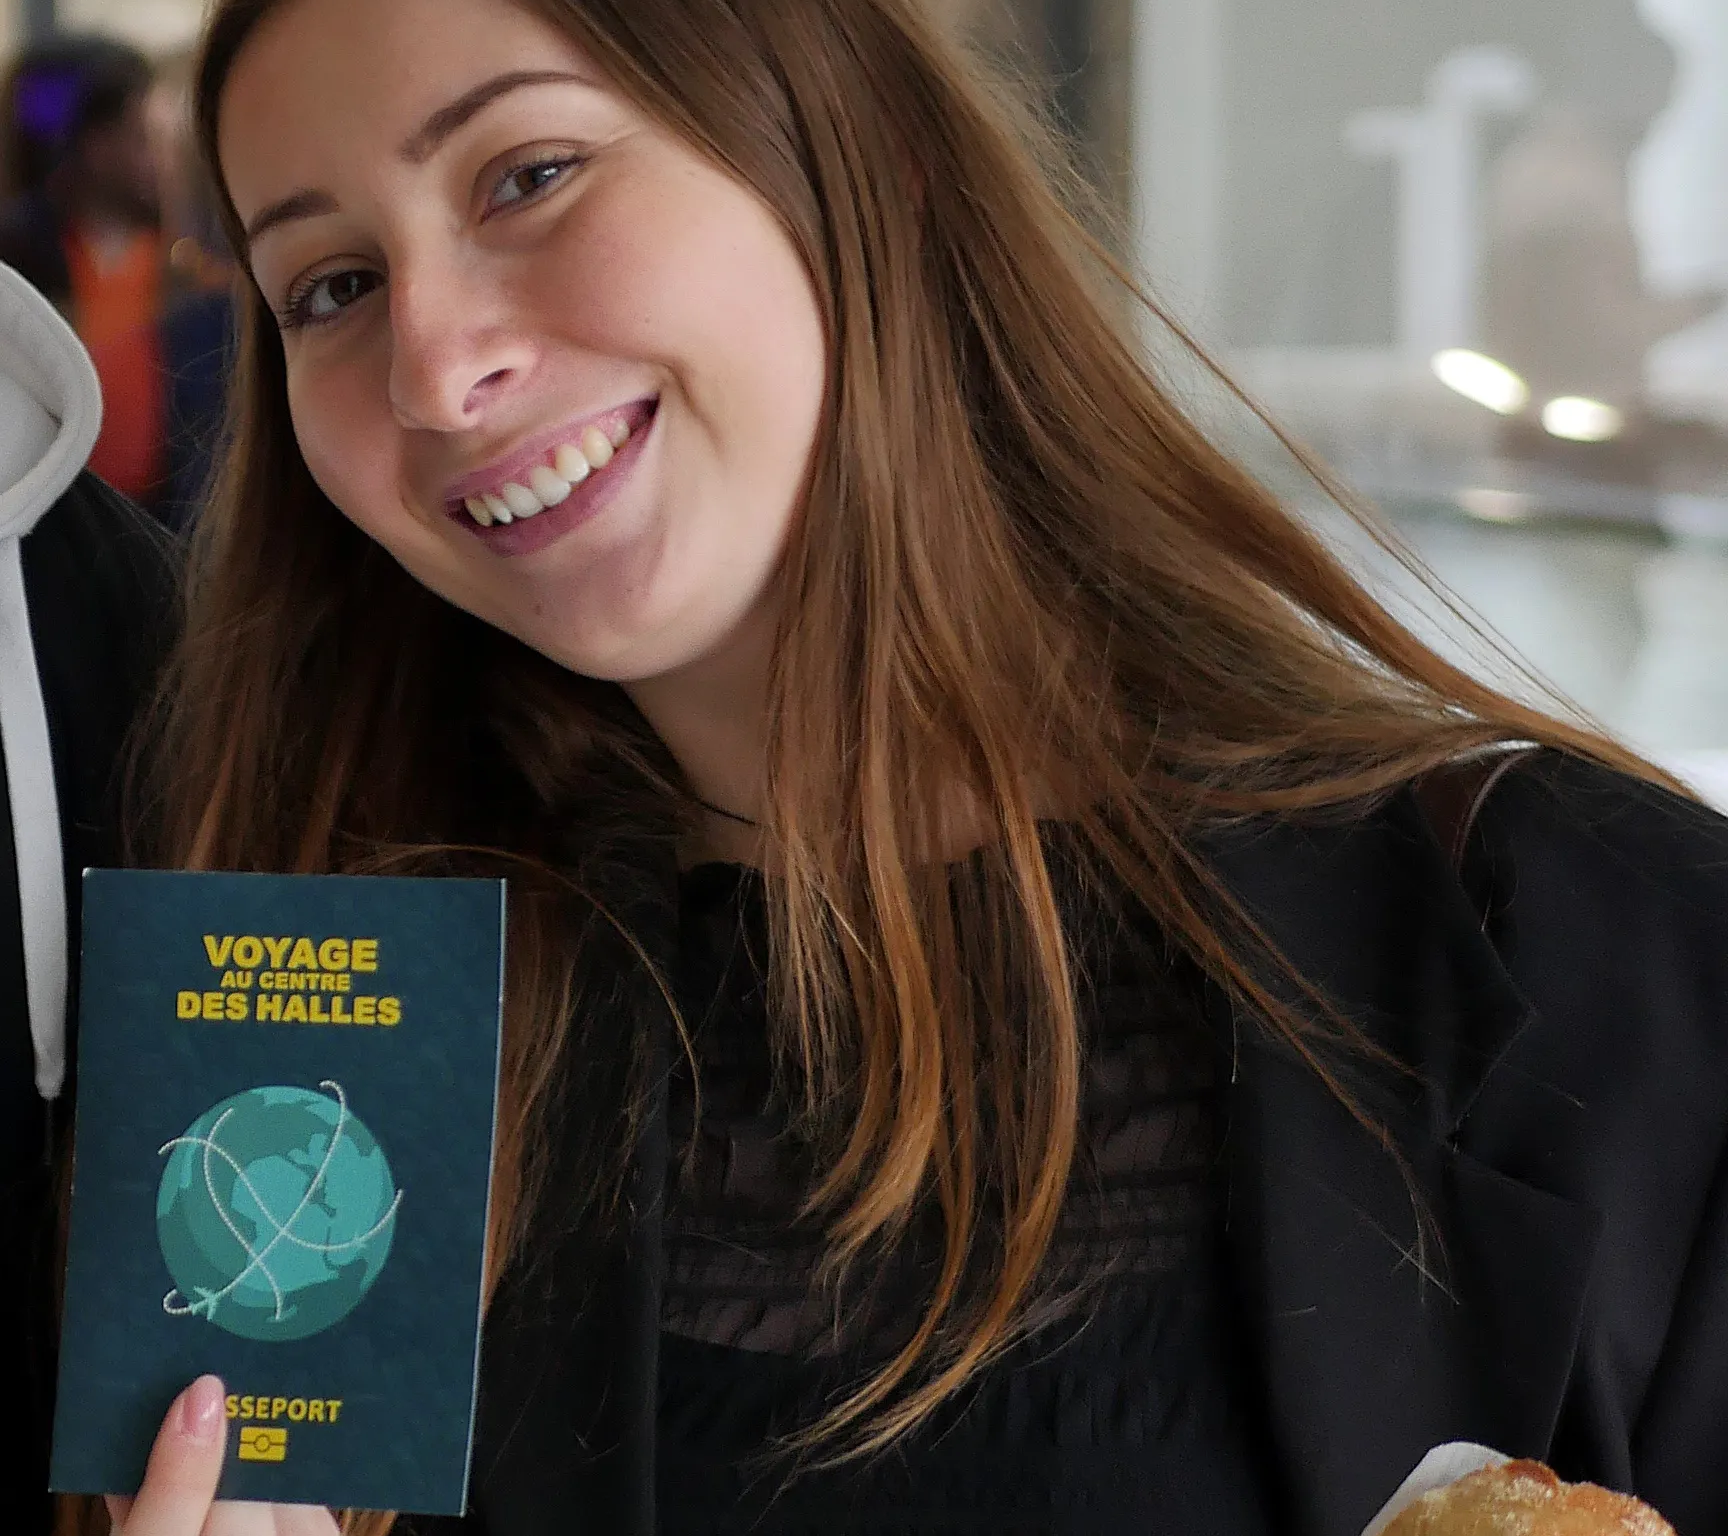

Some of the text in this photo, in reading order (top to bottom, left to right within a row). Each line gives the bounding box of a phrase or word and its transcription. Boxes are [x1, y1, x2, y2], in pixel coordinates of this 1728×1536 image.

[203, 934, 379, 972] VOYAGE
[220, 970, 352, 992] AU CENTRE
[176, 990, 402, 1027] DES HALLES
[224, 1393, 344, 1424] SSEPORT
